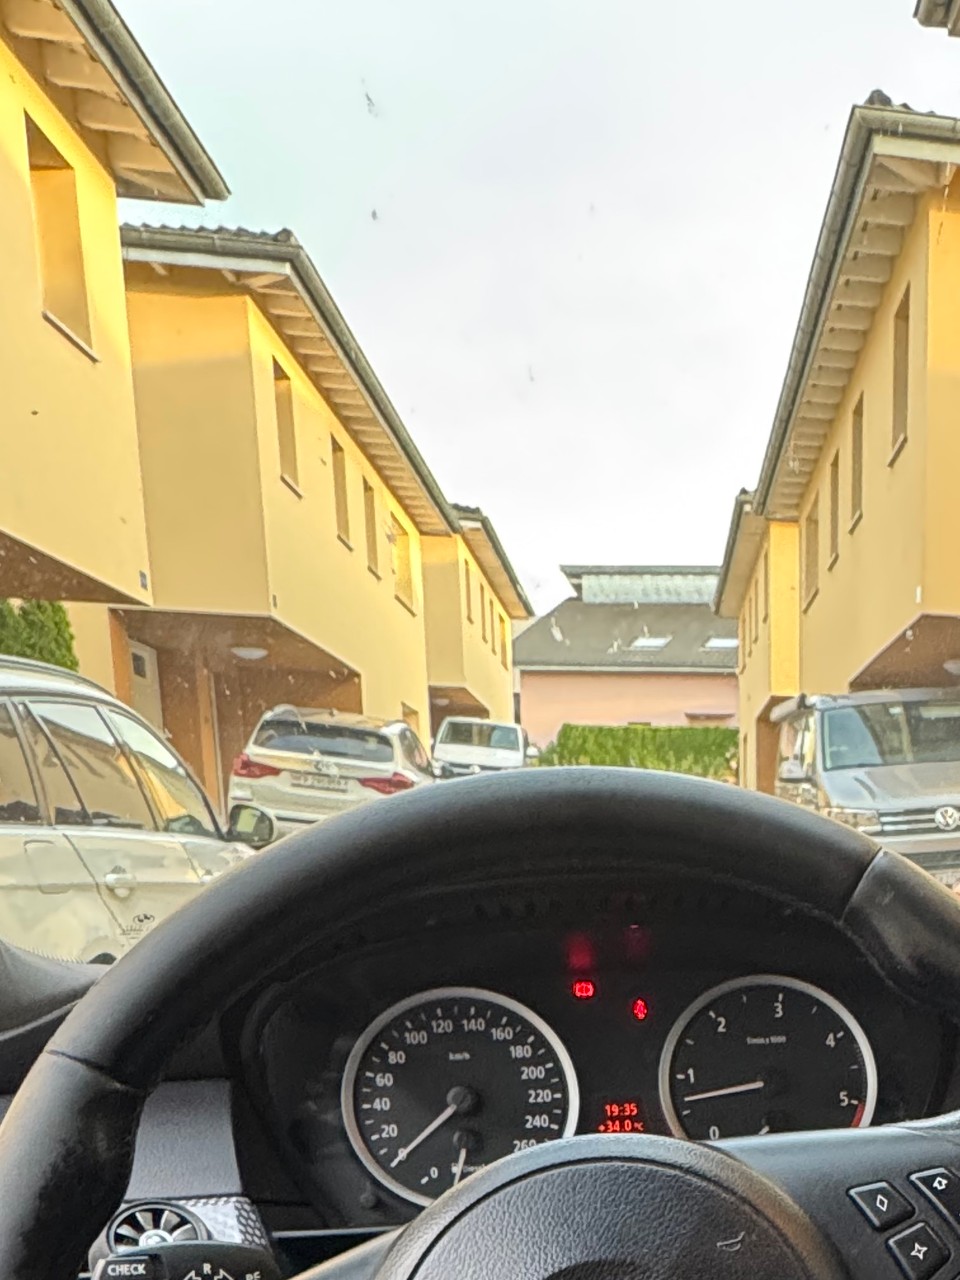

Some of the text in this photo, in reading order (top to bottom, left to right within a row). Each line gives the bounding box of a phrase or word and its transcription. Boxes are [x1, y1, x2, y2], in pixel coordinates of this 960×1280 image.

[773, 1002, 783, 1018] 3
[431, 1019, 453, 1034] 120
[461, 1017, 486, 1032] 140
[716, 1017, 727, 1033] 2
[404, 1030, 428, 1045] 100
[490, 1026, 513, 1041] 160
[825, 1032, 836, 1047] 4
[387, 1050, 406, 1065] 80
[509, 1044, 532, 1059] 180
[375, 1072, 394, 1087] 60
[520, 1065, 545, 1080] 200
[687, 1068, 695, 1084] 1
[372, 1097, 391, 1111] 40
[527, 1089, 552, 1104] 220
[839, 1091, 849, 1107] 5
[604, 1102, 638, 1117] 19:35
[524, 1114, 549, 1129] 240
[380, 1123, 398, 1138] 20
[708, 1125, 720, 1140] 0
[107, 1263, 147, 1277] CHECK
[202, 1262, 212, 1275] R
